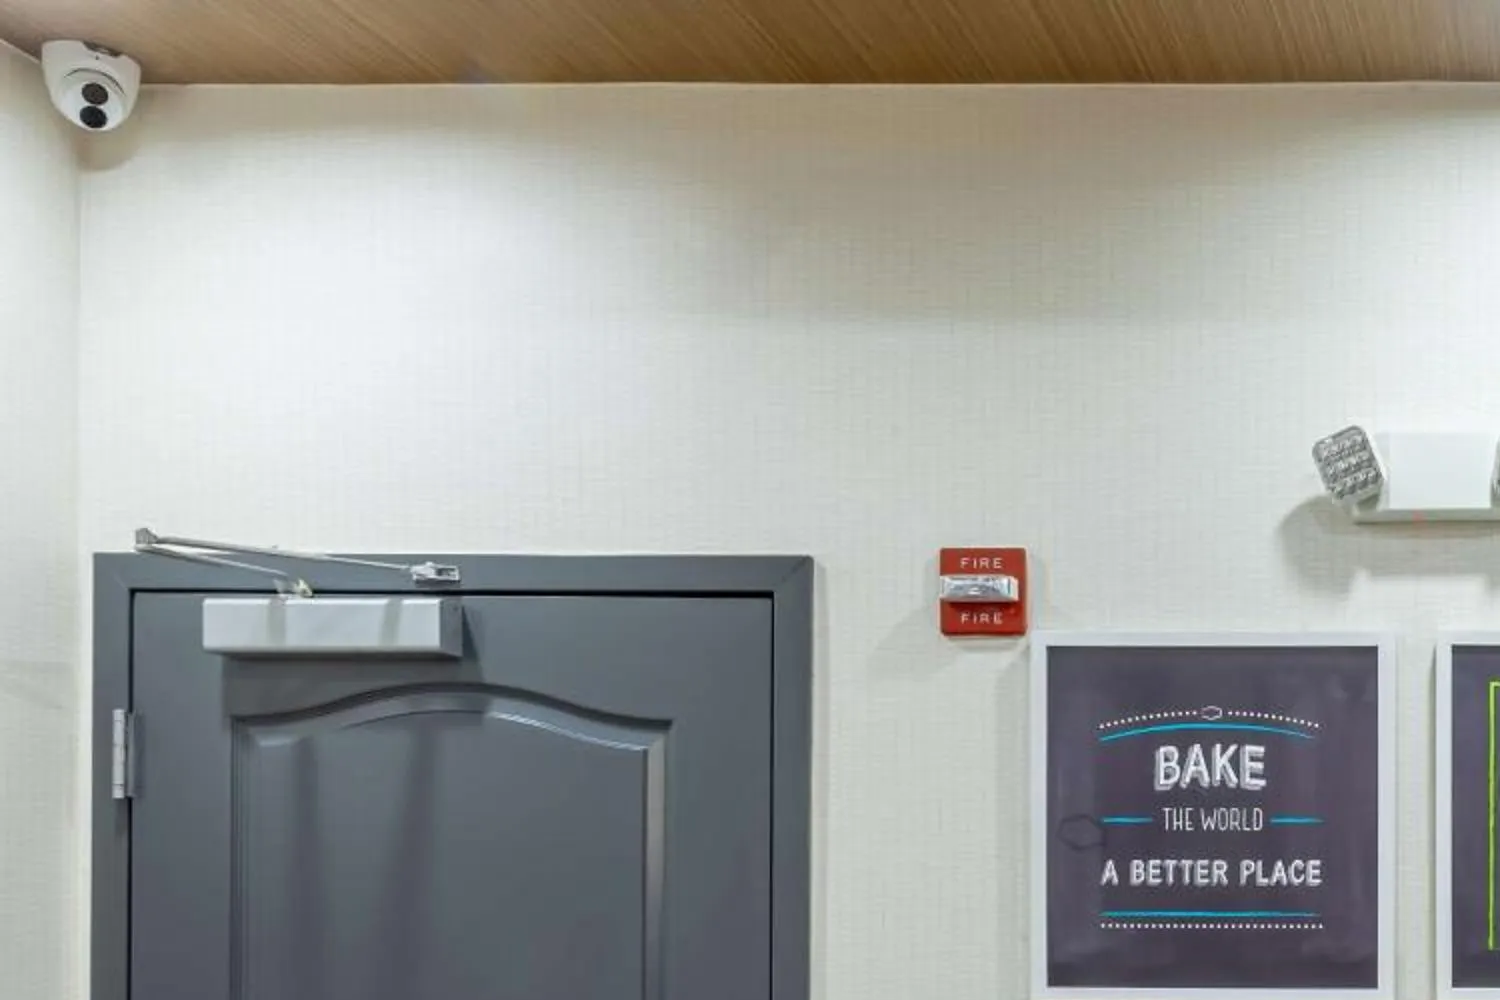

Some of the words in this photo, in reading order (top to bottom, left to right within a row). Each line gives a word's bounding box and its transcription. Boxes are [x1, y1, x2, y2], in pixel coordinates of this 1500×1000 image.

[959, 557, 1003, 569] FIRE
[960, 612, 1003, 625] FIRE
[1154, 743, 1268, 791] BAKE
[1162, 807, 1195, 831] THE
[1201, 807, 1263, 831] WORLD
[1100, 859, 1119, 887] A
[1129, 859, 1228, 887] BETTER
[1239, 859, 1323, 887] PLACE
